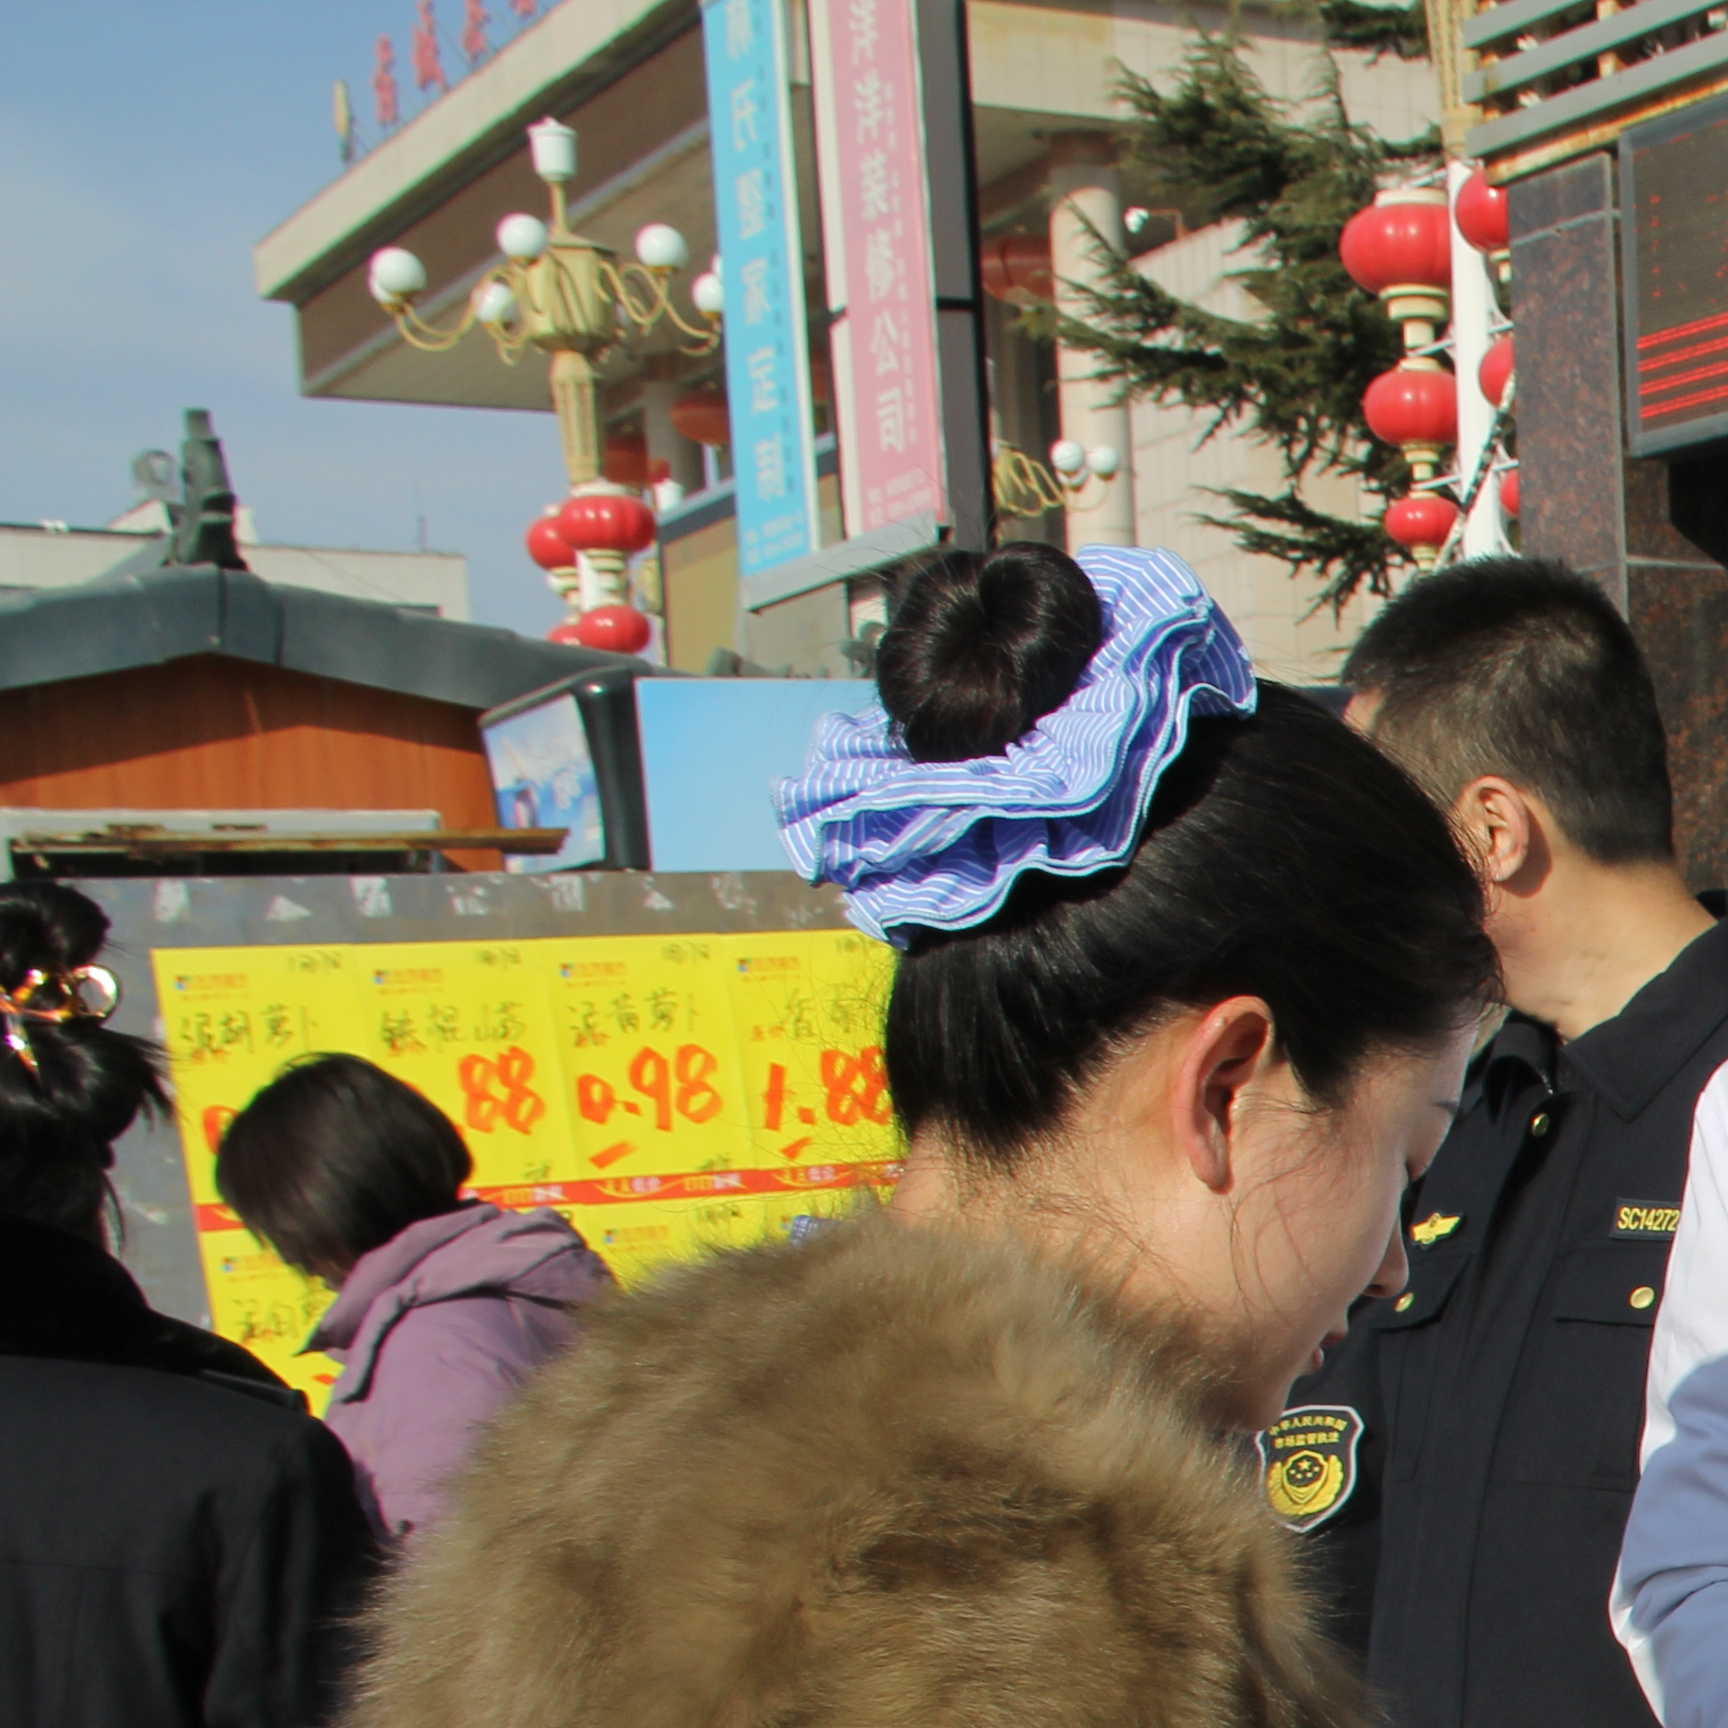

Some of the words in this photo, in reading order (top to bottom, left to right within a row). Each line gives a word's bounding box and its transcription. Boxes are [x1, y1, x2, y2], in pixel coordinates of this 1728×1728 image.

[576, 1043, 723, 1133] 0.98
[764, 1046, 894, 1132] 1.88
[1268, 1416, 1348, 1436] 中华人民共和国
